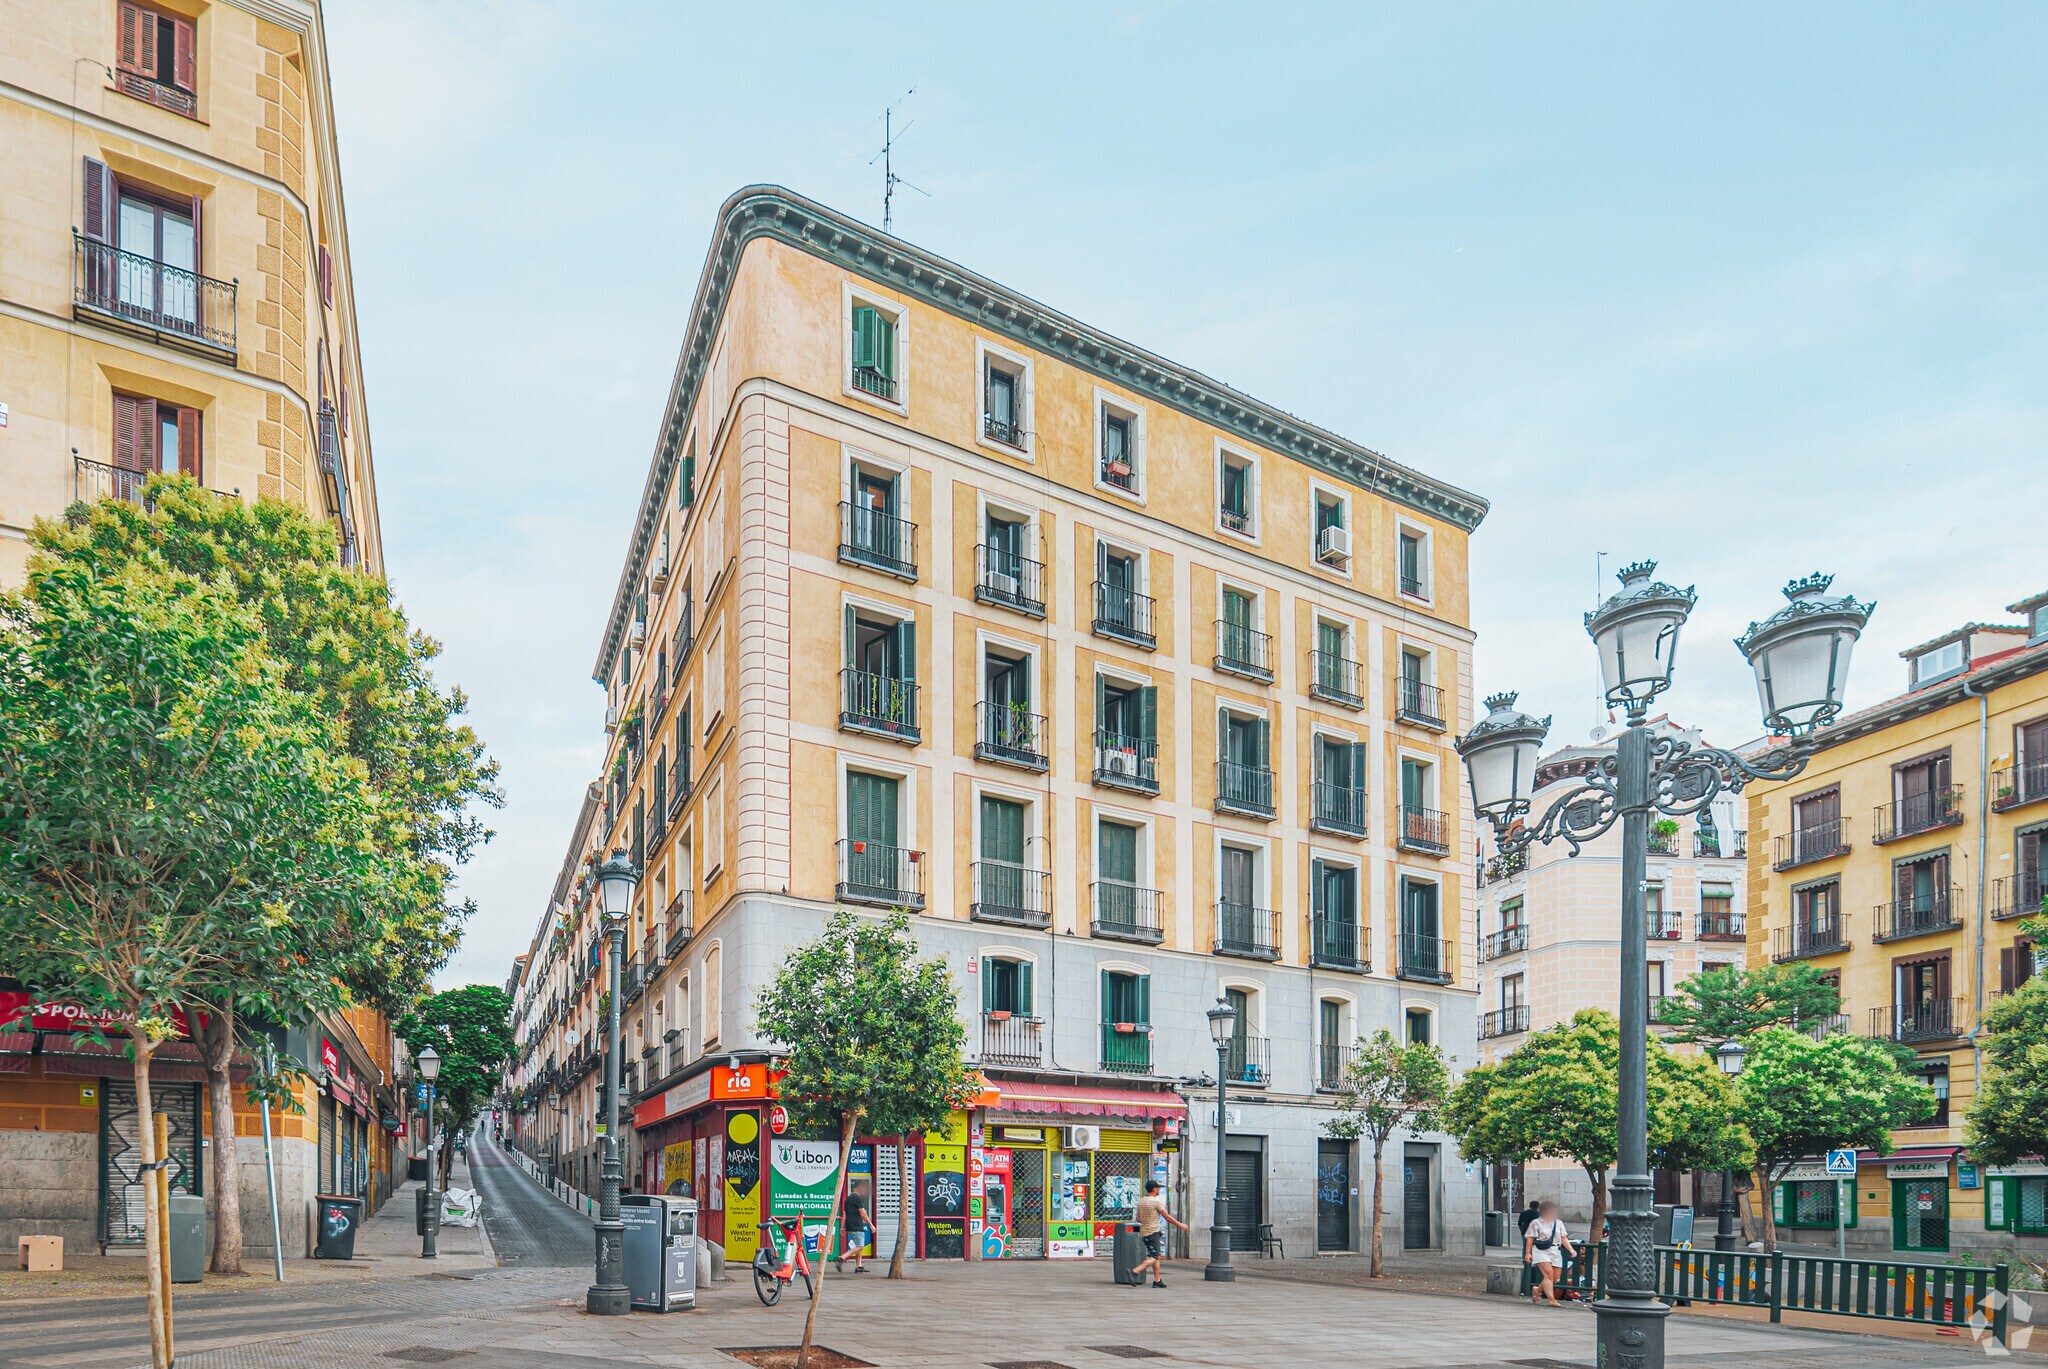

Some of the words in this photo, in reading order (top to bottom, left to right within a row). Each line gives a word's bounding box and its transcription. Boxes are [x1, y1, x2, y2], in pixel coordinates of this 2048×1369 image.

[727, 1071, 751, 1088] ria
[772, 1110, 784, 1124] ria
[795, 1150, 832, 1164] Libon
[1893, 1162, 1937, 1171] MALIK
